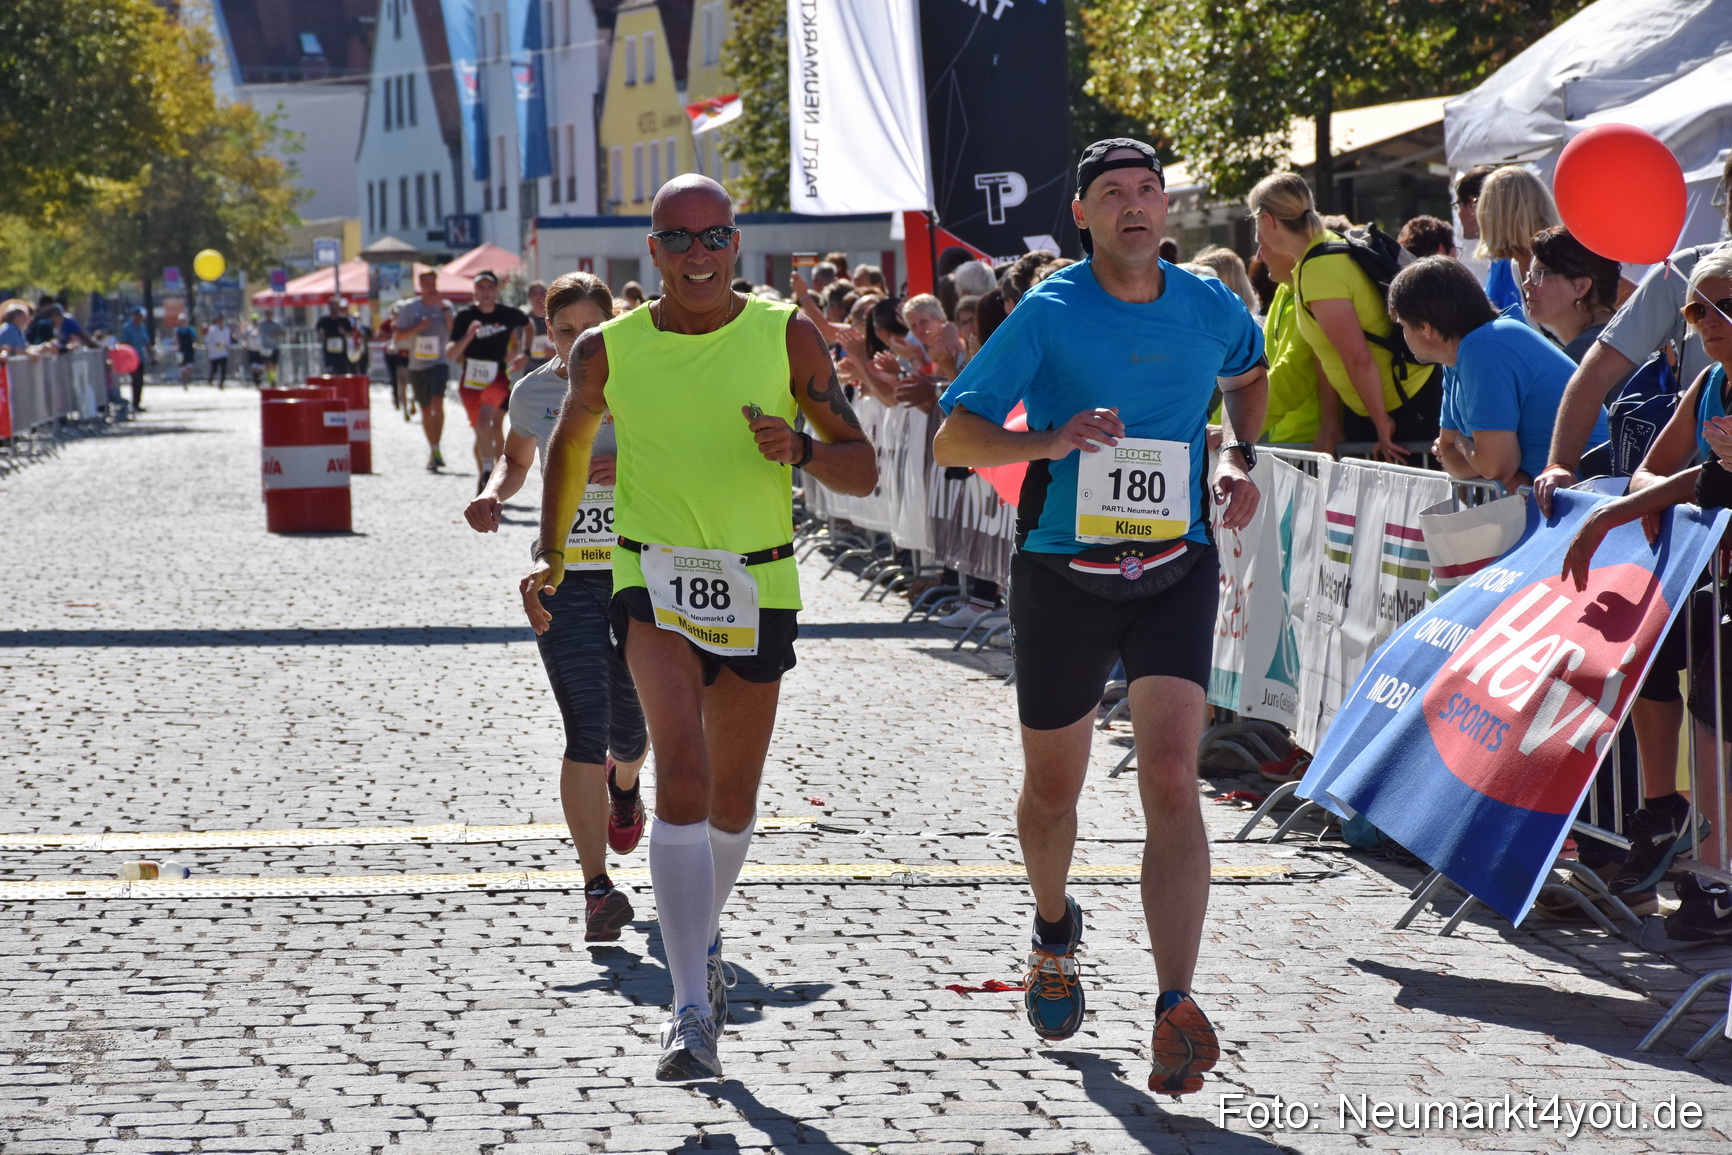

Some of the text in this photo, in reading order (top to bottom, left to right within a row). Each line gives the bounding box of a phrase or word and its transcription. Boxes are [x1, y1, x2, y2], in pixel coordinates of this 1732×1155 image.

[1114, 447, 1162, 462] BOCK
[583, 491, 615, 500] OCK
[1108, 468, 1166, 503] 180
[571, 507, 615, 534] 239
[1101, 504, 1160, 515] PARTL Neumarkt
[1115, 520, 1152, 536] Klaus
[581, 549, 611, 561] Heike
[674, 555, 723, 571] BOCK
[1121, 565, 1185, 595] BAYERN
[1469, 567, 1524, 592] STORE
[670, 576, 731, 610] 188
[671, 604, 724, 622] PARTL Neumarkt
[678, 616, 729, 644] Matthias
[1449, 582, 1637, 758] Hervi
[1261, 688, 1279, 708] Jura
[1438, 692, 1511, 752] SPORTS
